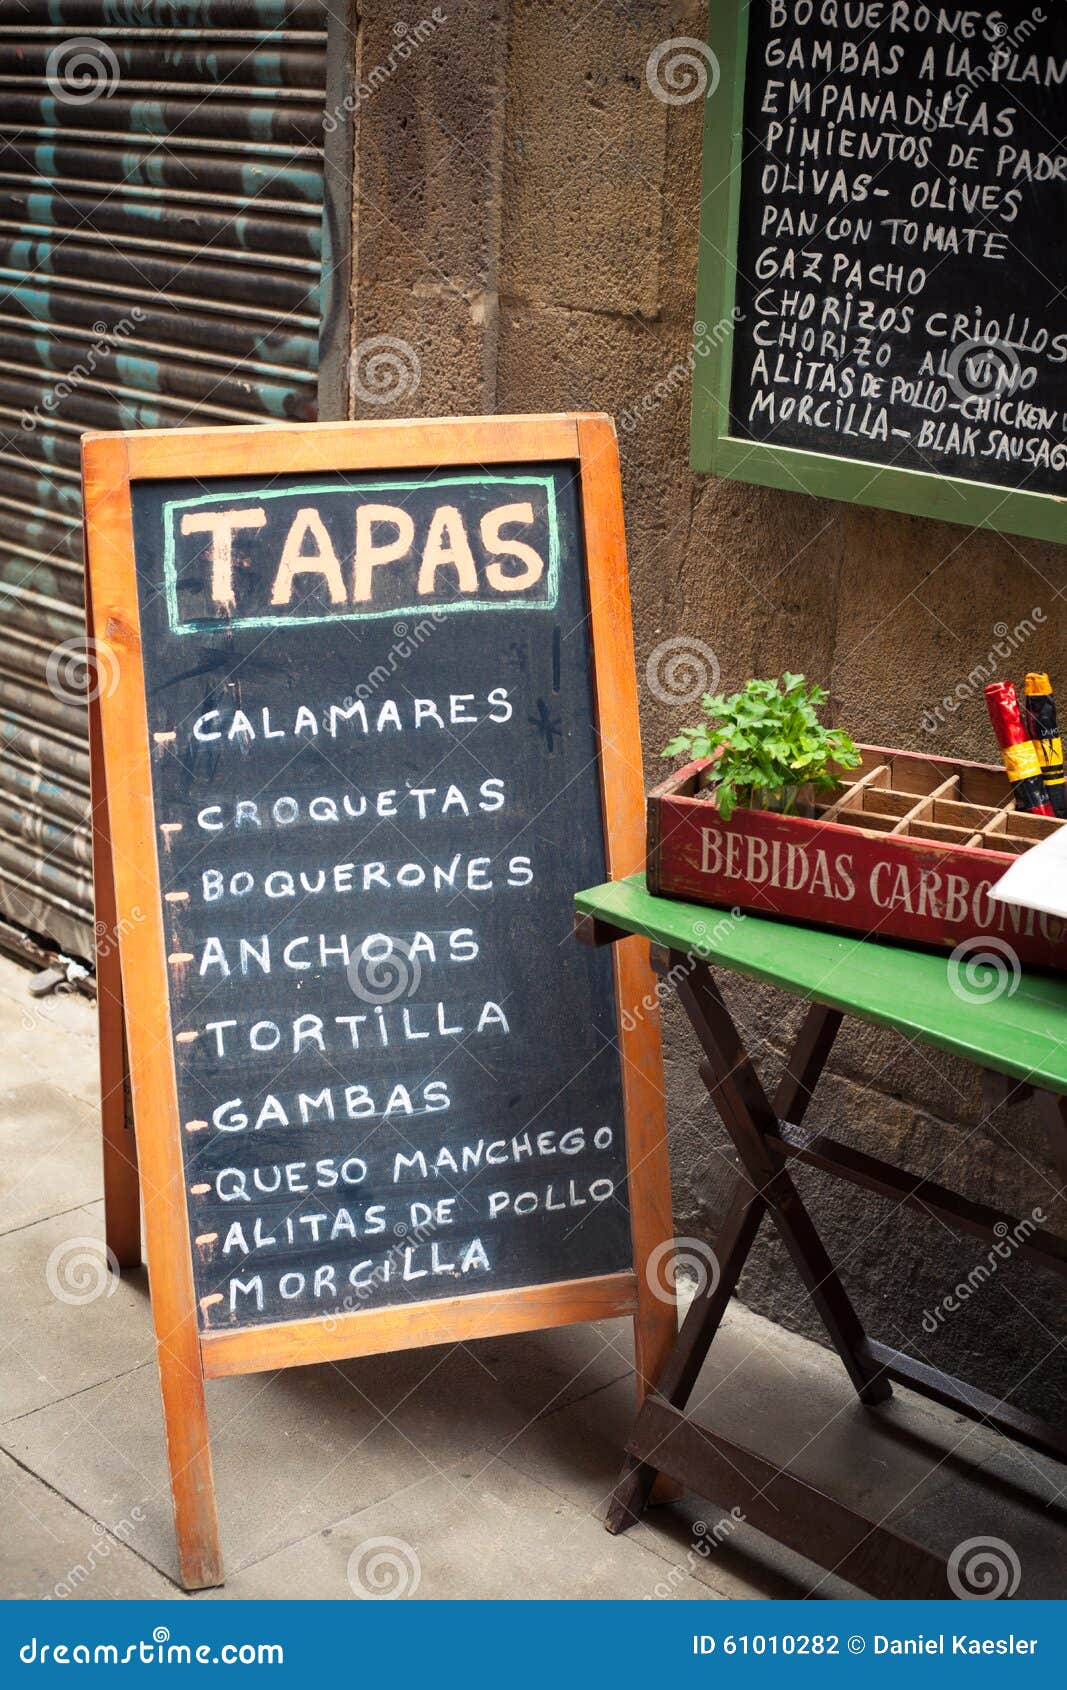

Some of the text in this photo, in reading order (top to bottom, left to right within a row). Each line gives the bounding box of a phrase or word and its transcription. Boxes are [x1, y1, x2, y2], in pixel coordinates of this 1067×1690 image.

[769, 0, 1003, 42] BOQUERONES
[765, 38, 1067, 87] GAMBAS A LA PLAN
[947, 144, 984, 170] DE
[996, 144, 1067, 182] PADR
[761, 205, 1009, 259] PAN CON TOMATE
[861, 373, 887, 399] DE
[918, 349, 954, 380] AL
[918, 419, 981, 457] BLAK
[181, 501, 544, 605] TAPAS
[192, 687, 514, 740] CALAMARES
[196, 777, 506, 831] CROQUETAS
[201, 853, 534, 903] BOQUERONES
[699, 826, 1067, 944] BEBIDAS CARBONIC
[199, 927, 480, 976] ANCHOAS
[205, 1001, 510, 1058] TORTILLA
[211, 1080, 452, 1133] GAMBAS
[215, 1125, 614, 1201] QUESO MANCHEGO
[222, 1178, 614, 1256] ALITAS DE POLLO
[229, 1237, 492, 1312] MORCILLA
